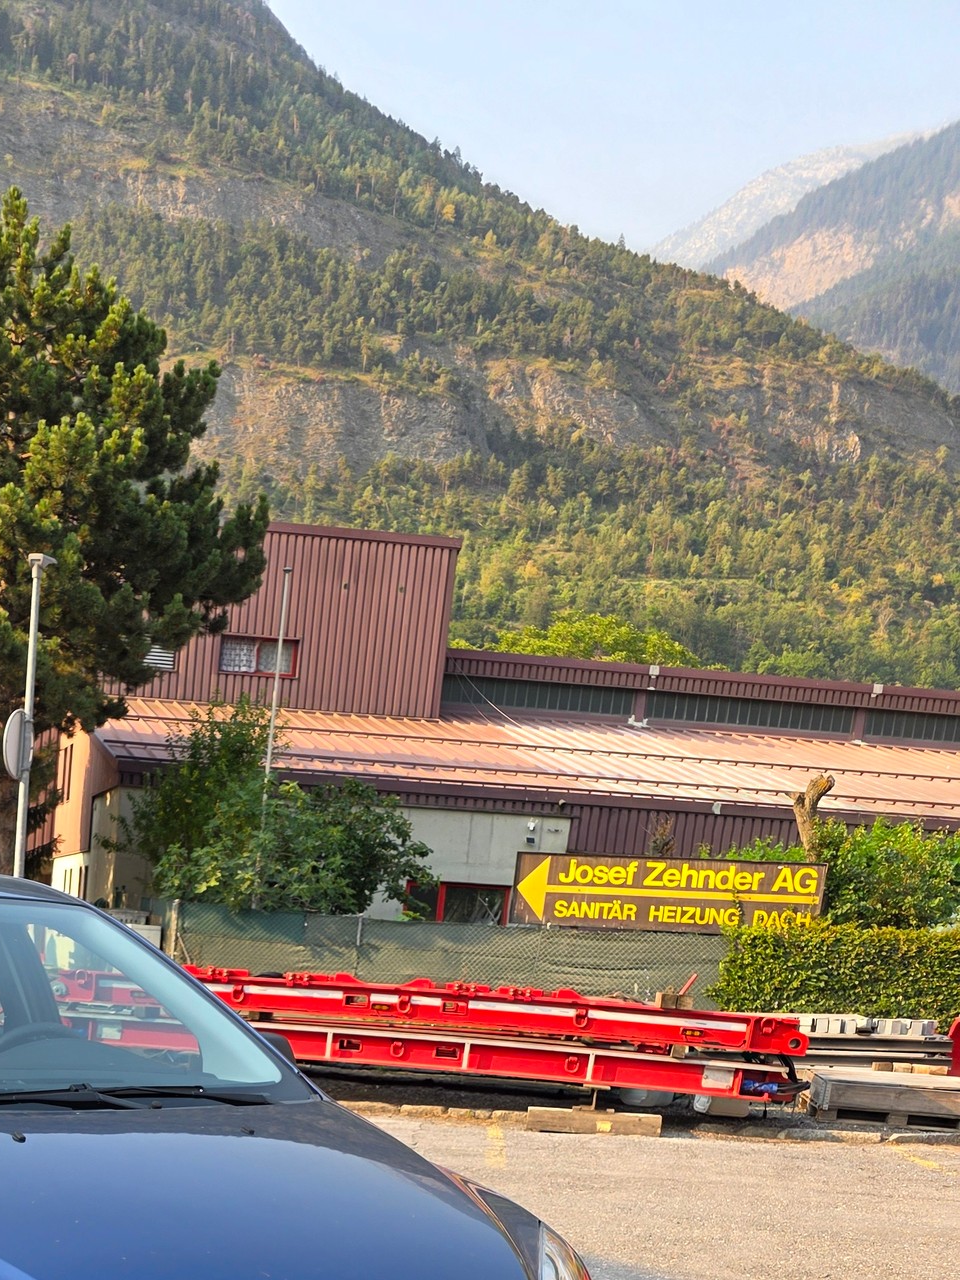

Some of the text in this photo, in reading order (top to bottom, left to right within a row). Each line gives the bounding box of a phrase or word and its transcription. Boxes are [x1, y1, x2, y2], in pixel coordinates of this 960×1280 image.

[558, 858, 818, 894] Josef Zehnder AG
[553, 900, 811, 928] SANITÄR HEIZUNG DACH
